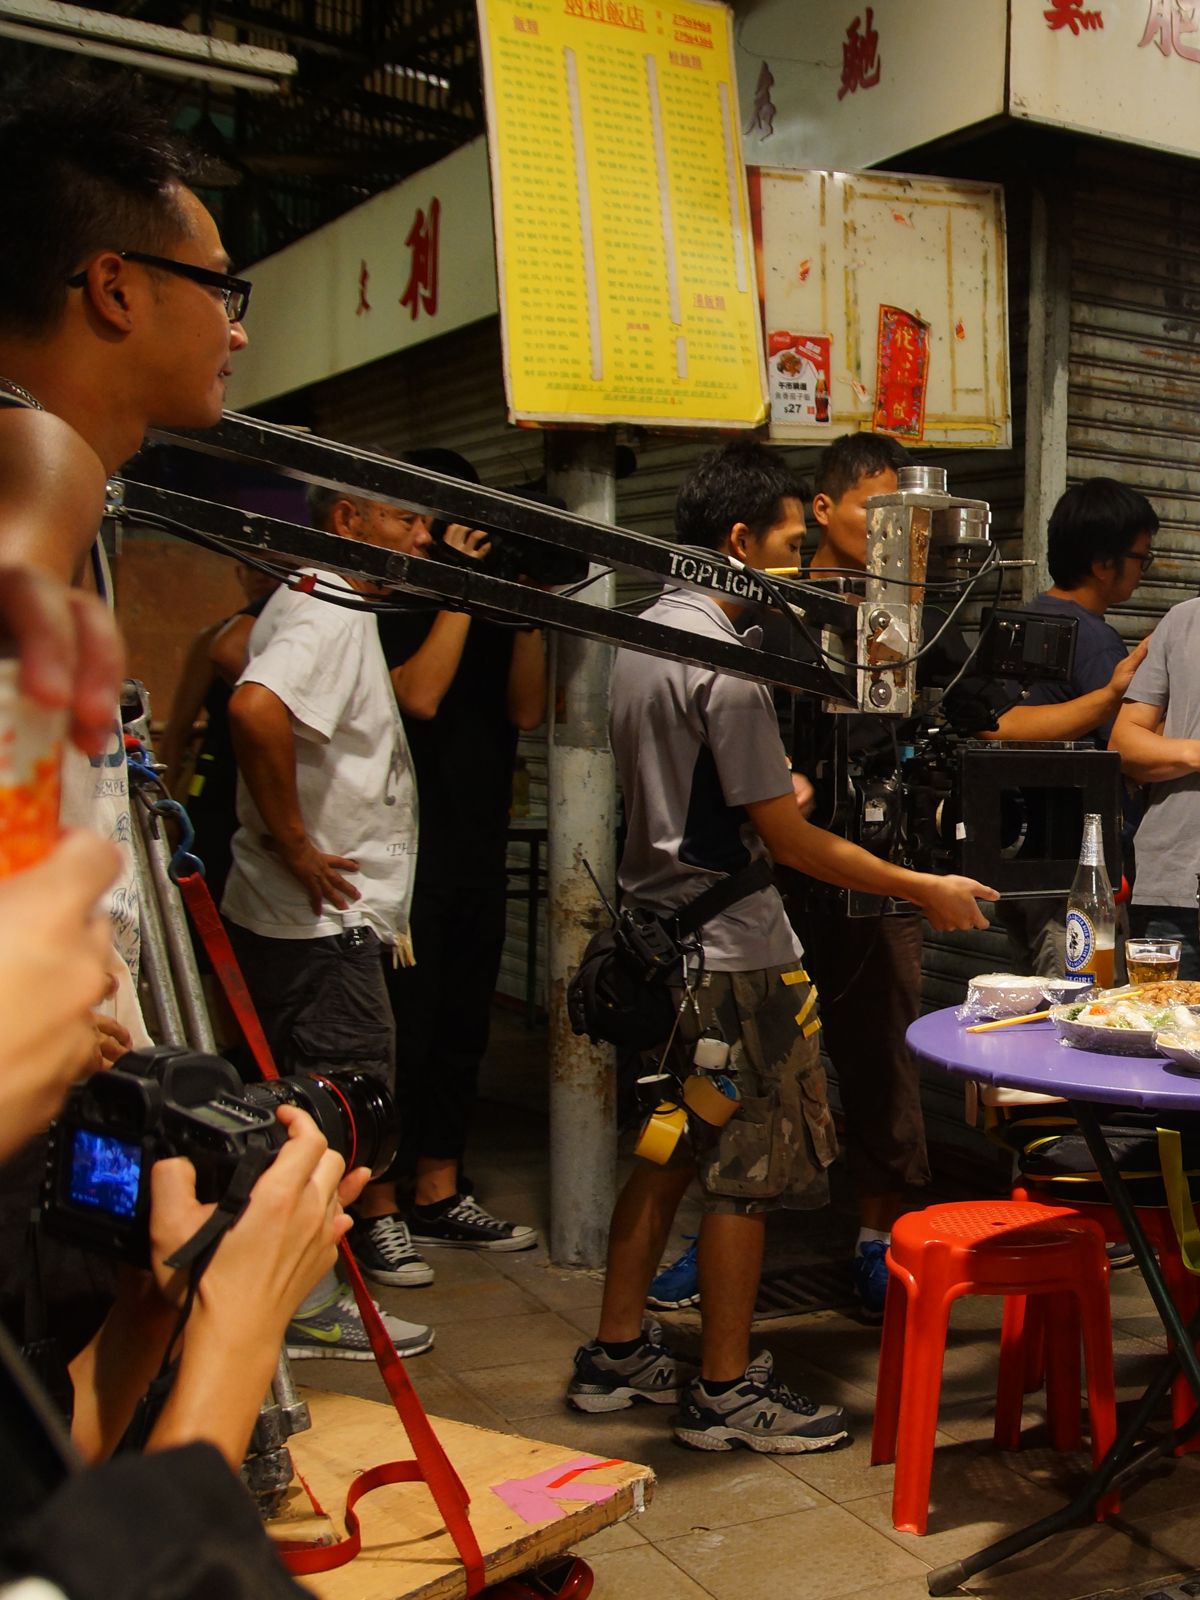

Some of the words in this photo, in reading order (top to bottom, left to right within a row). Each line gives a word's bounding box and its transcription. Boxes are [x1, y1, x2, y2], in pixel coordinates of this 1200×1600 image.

[783, 403, 802, 413] $27
[650, 1367, 674, 1384] N
[753, 1411, 777, 1429] N
